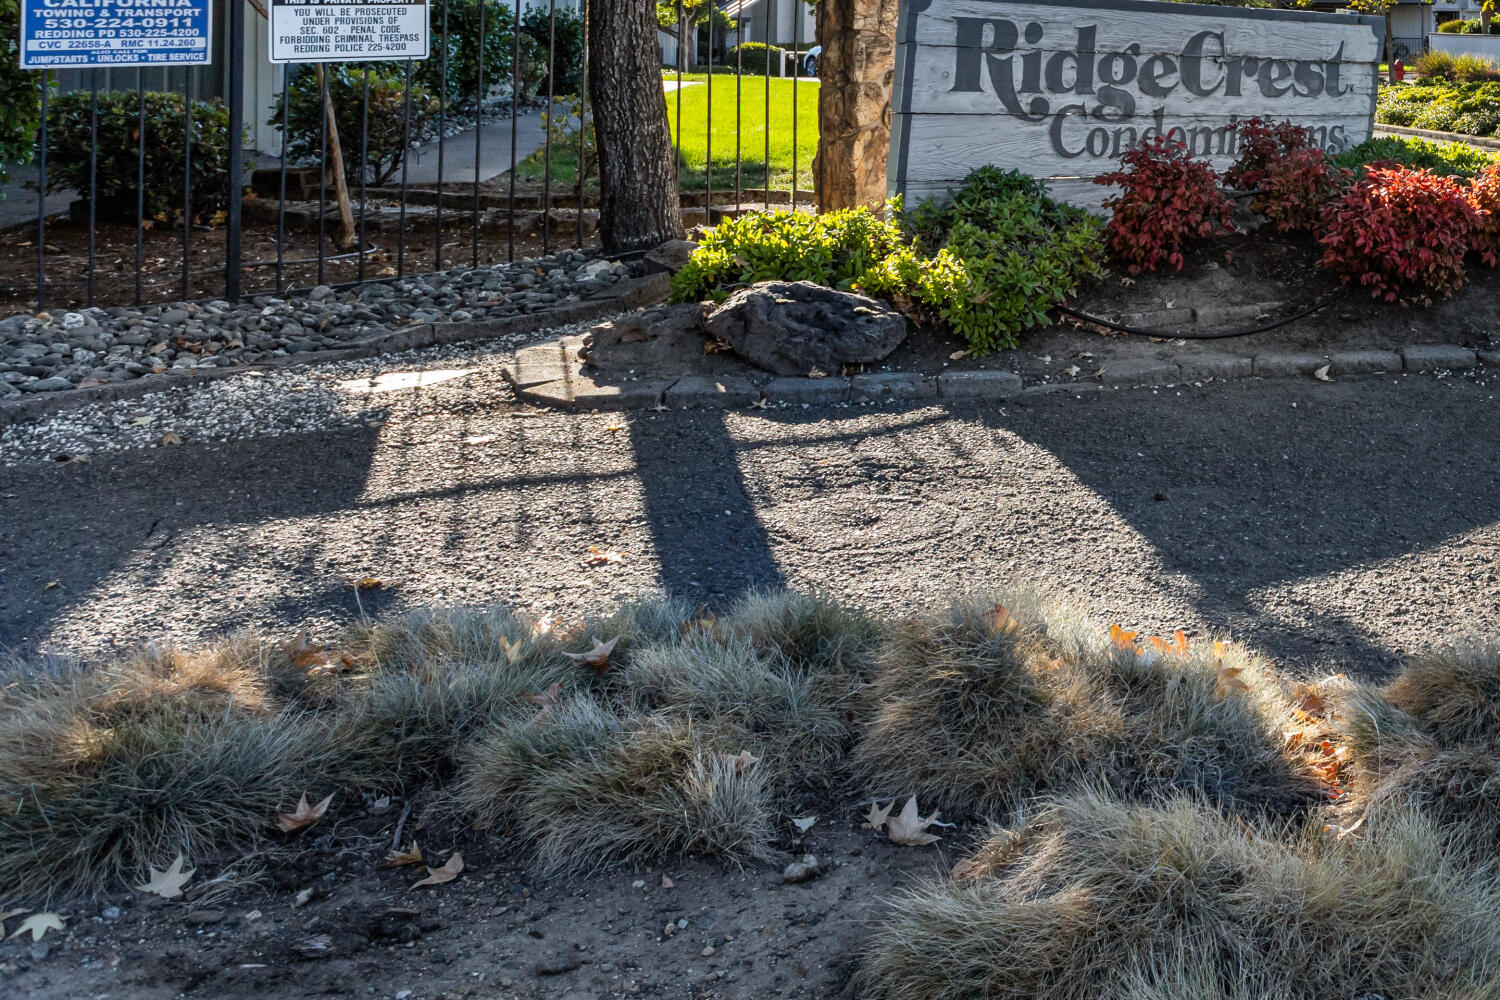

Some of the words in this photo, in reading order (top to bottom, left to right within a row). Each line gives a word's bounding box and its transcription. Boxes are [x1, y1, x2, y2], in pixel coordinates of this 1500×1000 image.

[33, 9, 95, 18] TOWING
[100, 9, 110, 17] &
[115, 8, 202, 17] TRANSPORT
[294, 8, 310, 16] YOU
[315, 8, 335, 16] WILL
[341, 8, 351, 16] BE
[355, 7, 407, 15] PROSECUTED
[45, 18, 192, 28] 530-224-0911
[303, 17, 330, 25] UNDER
[335, 17, 384, 25] PROVISIONS
[388, 16, 398, 24] OF
[35, 30, 95, 38] REDDING
[119, 28, 200, 37] 530-225-4200
[323, 26, 339, 34] 602
[351, 25, 376, 33] PENAL
[381, 25, 400, 33] CODE
[39, 41, 62, 49] CVC
[148, 39, 196, 47] 11.24.260
[280, 35, 330, 44] FORBIDDING
[335, 34, 374, 43] CRIMINAL
[380, 34, 419, 42] TRESPASS
[294, 44, 330, 53] REDDING
[335, 44, 363, 52] POLICE
[368, 42, 407, 51] 225-4200
[28, 55, 88, 64] JUMPSTARTS
[97, 54, 139, 62] UNLOCKS
[147, 53, 167, 61] TIRE
[950, 16, 1350, 122] RidgeCrest
